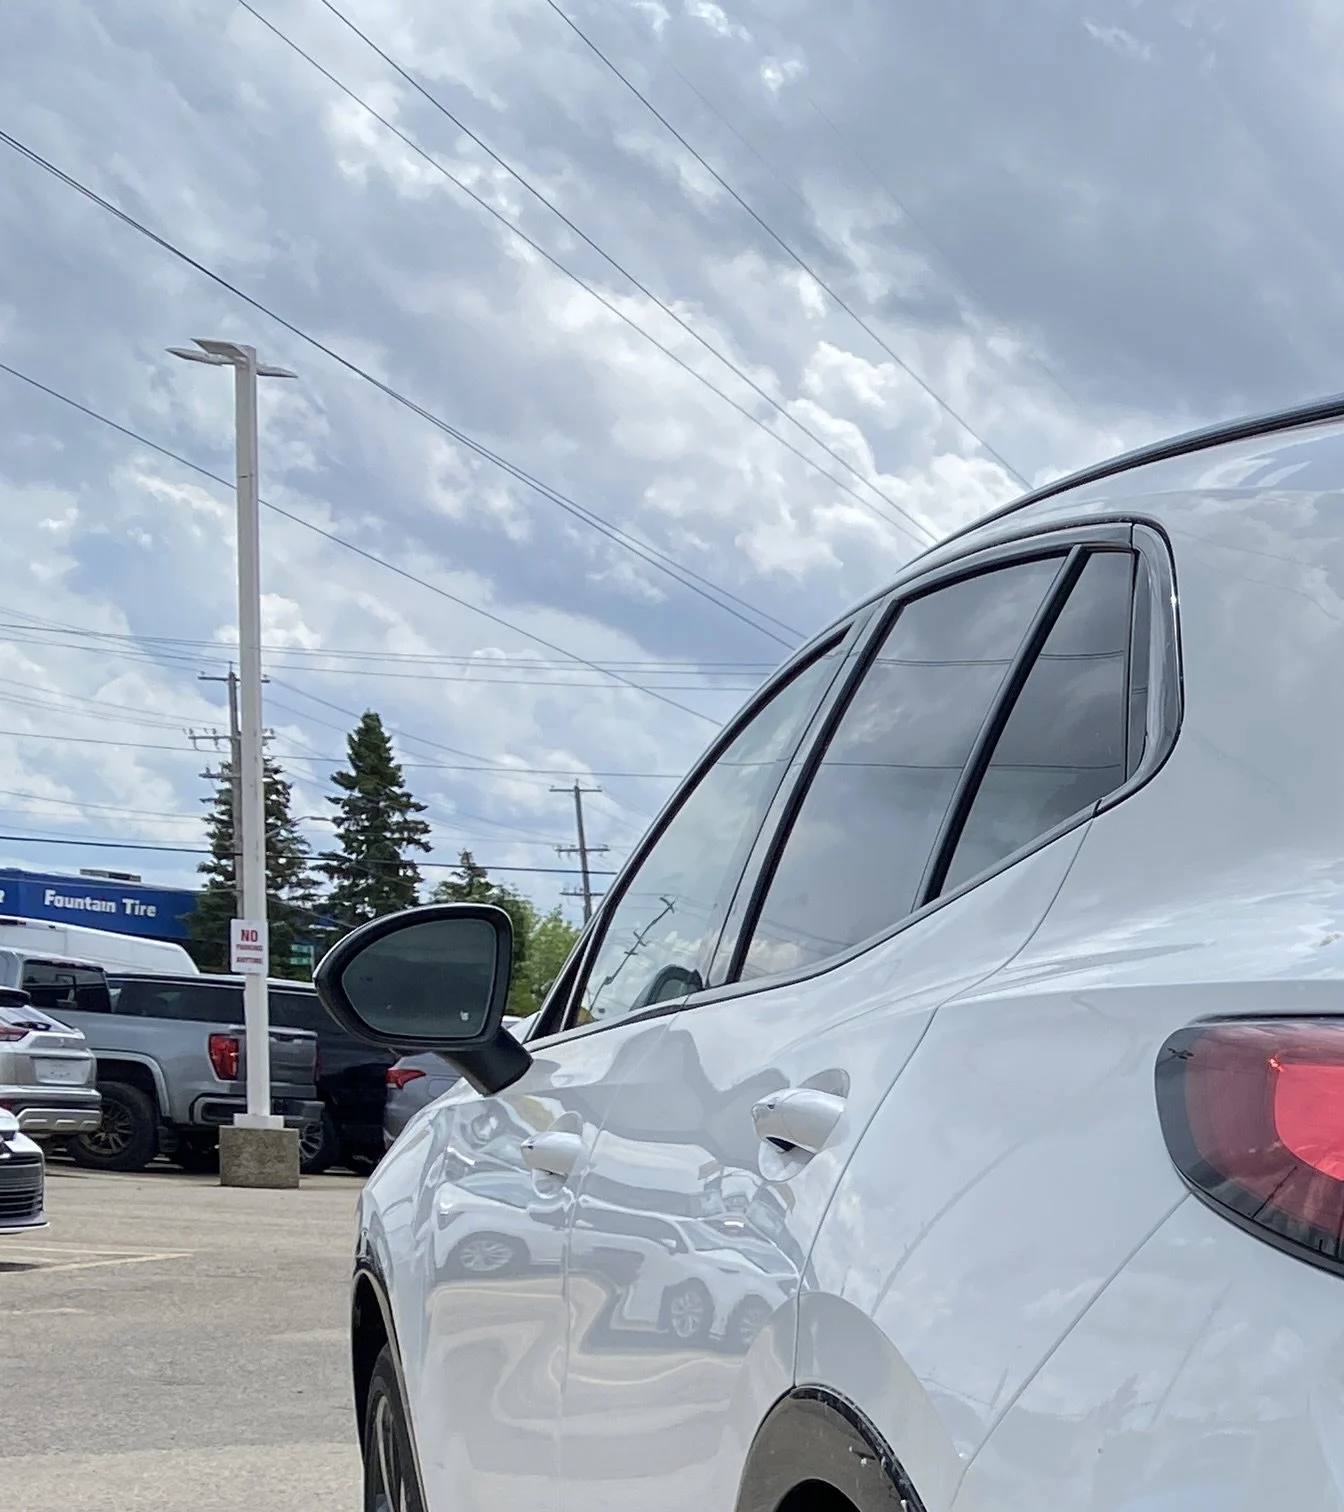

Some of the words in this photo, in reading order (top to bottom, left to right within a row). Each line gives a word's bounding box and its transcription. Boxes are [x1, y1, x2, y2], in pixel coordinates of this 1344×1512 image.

[44, 889, 116, 913] Fountain
[122, 898, 157, 917] Tire
[240, 929, 259, 942] NO
